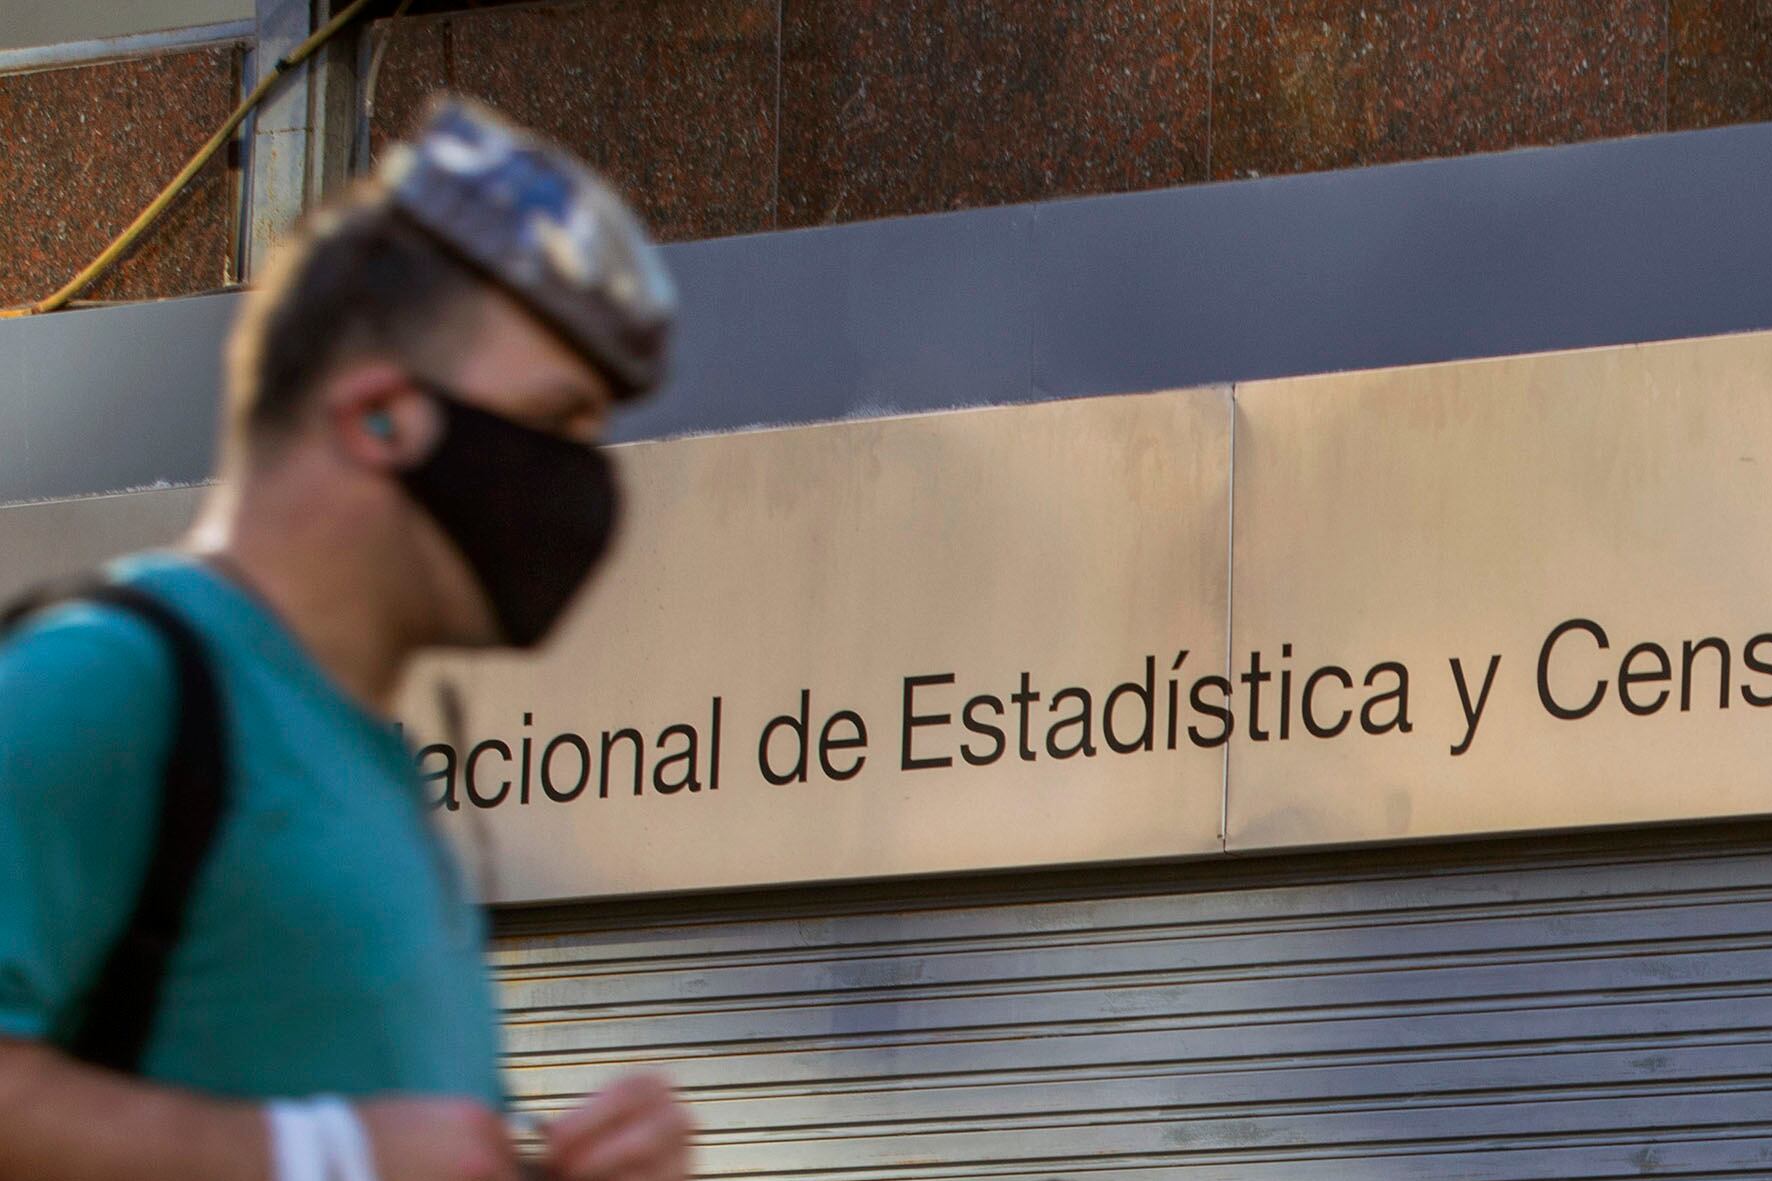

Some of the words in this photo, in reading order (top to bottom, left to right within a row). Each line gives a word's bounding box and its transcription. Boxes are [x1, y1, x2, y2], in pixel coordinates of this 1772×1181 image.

[396, 696, 722, 811] acional
[757, 689, 868, 786] de
[900, 651, 1413, 772] Estadística
[1449, 654, 1502, 756] y
